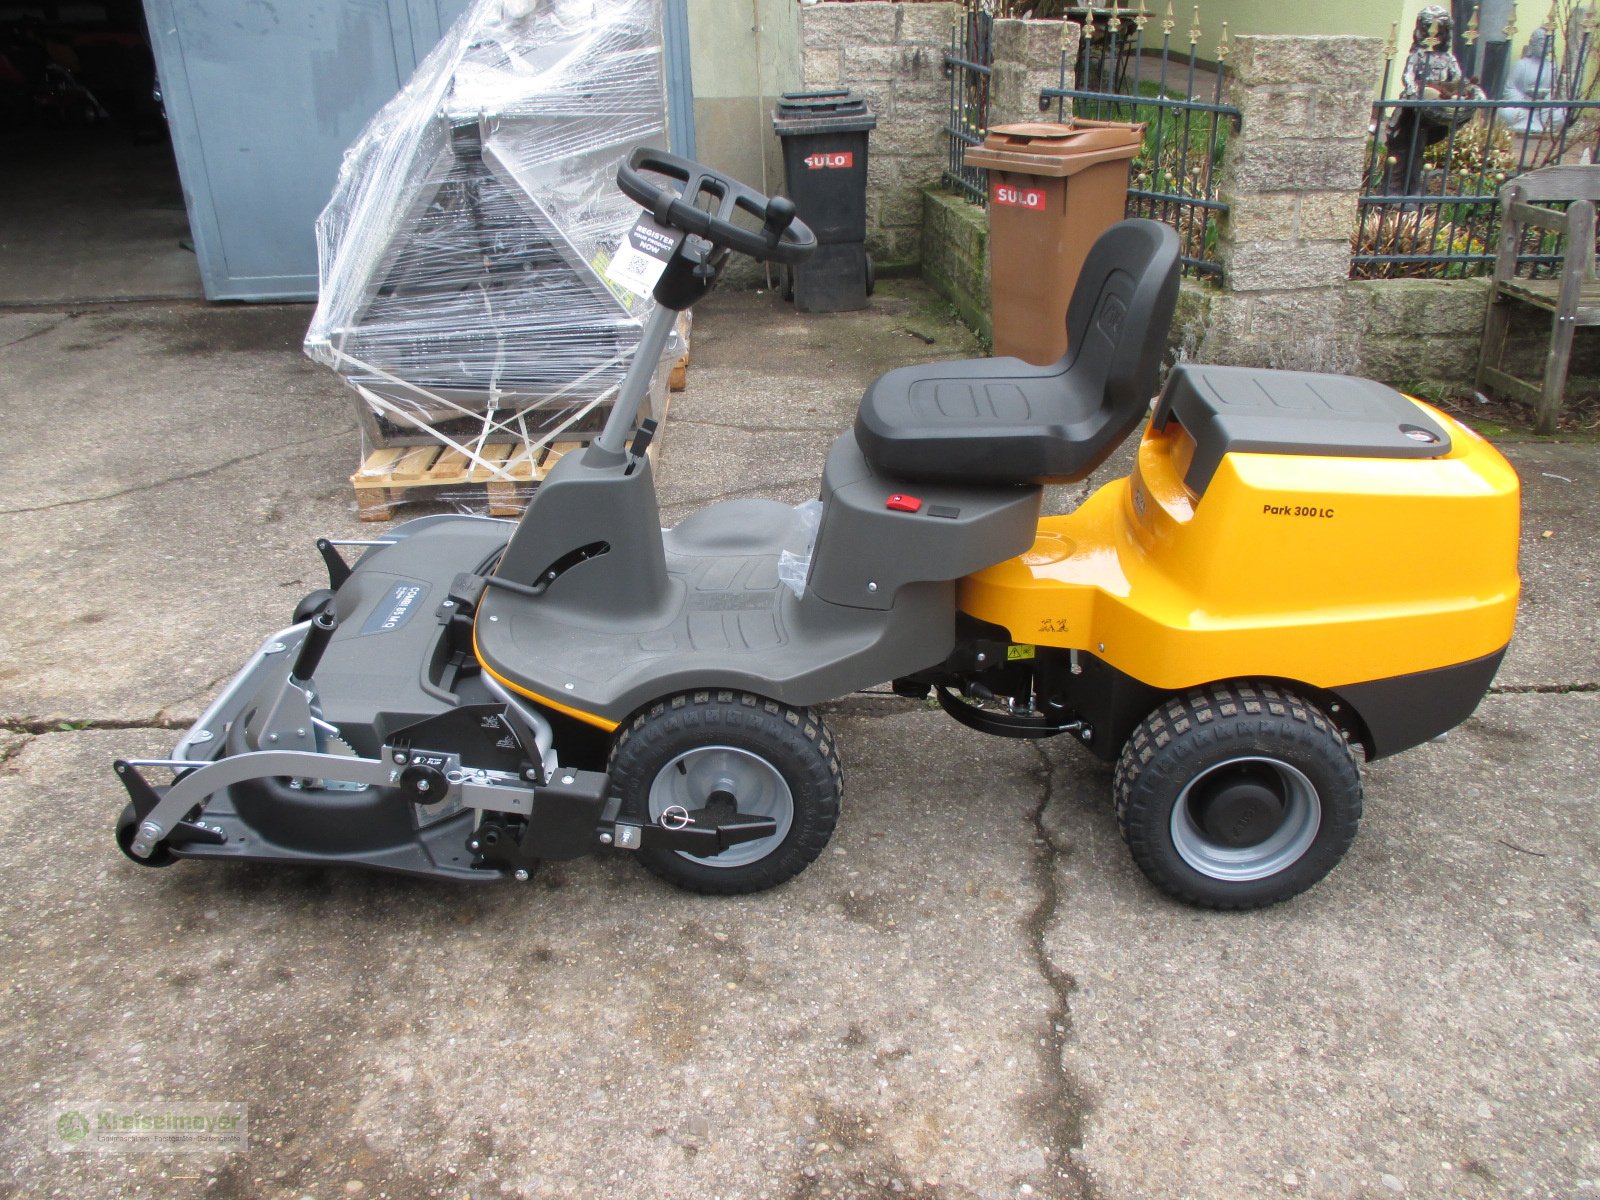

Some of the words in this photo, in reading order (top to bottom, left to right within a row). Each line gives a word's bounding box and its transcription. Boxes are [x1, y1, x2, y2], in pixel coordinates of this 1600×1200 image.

[804, 155, 846, 167] SULO
[998, 188, 1038, 206] SULO
[636, 225, 674, 246] REGISTER
[640, 240, 660, 254] NOW
[647, 237, 672, 251] PRODUCT
[1263, 504, 1292, 516] Park
[1294, 506, 1317, 517] 300
[1319, 508, 1335, 519] LC
[399, 587, 420, 606] COMBI
